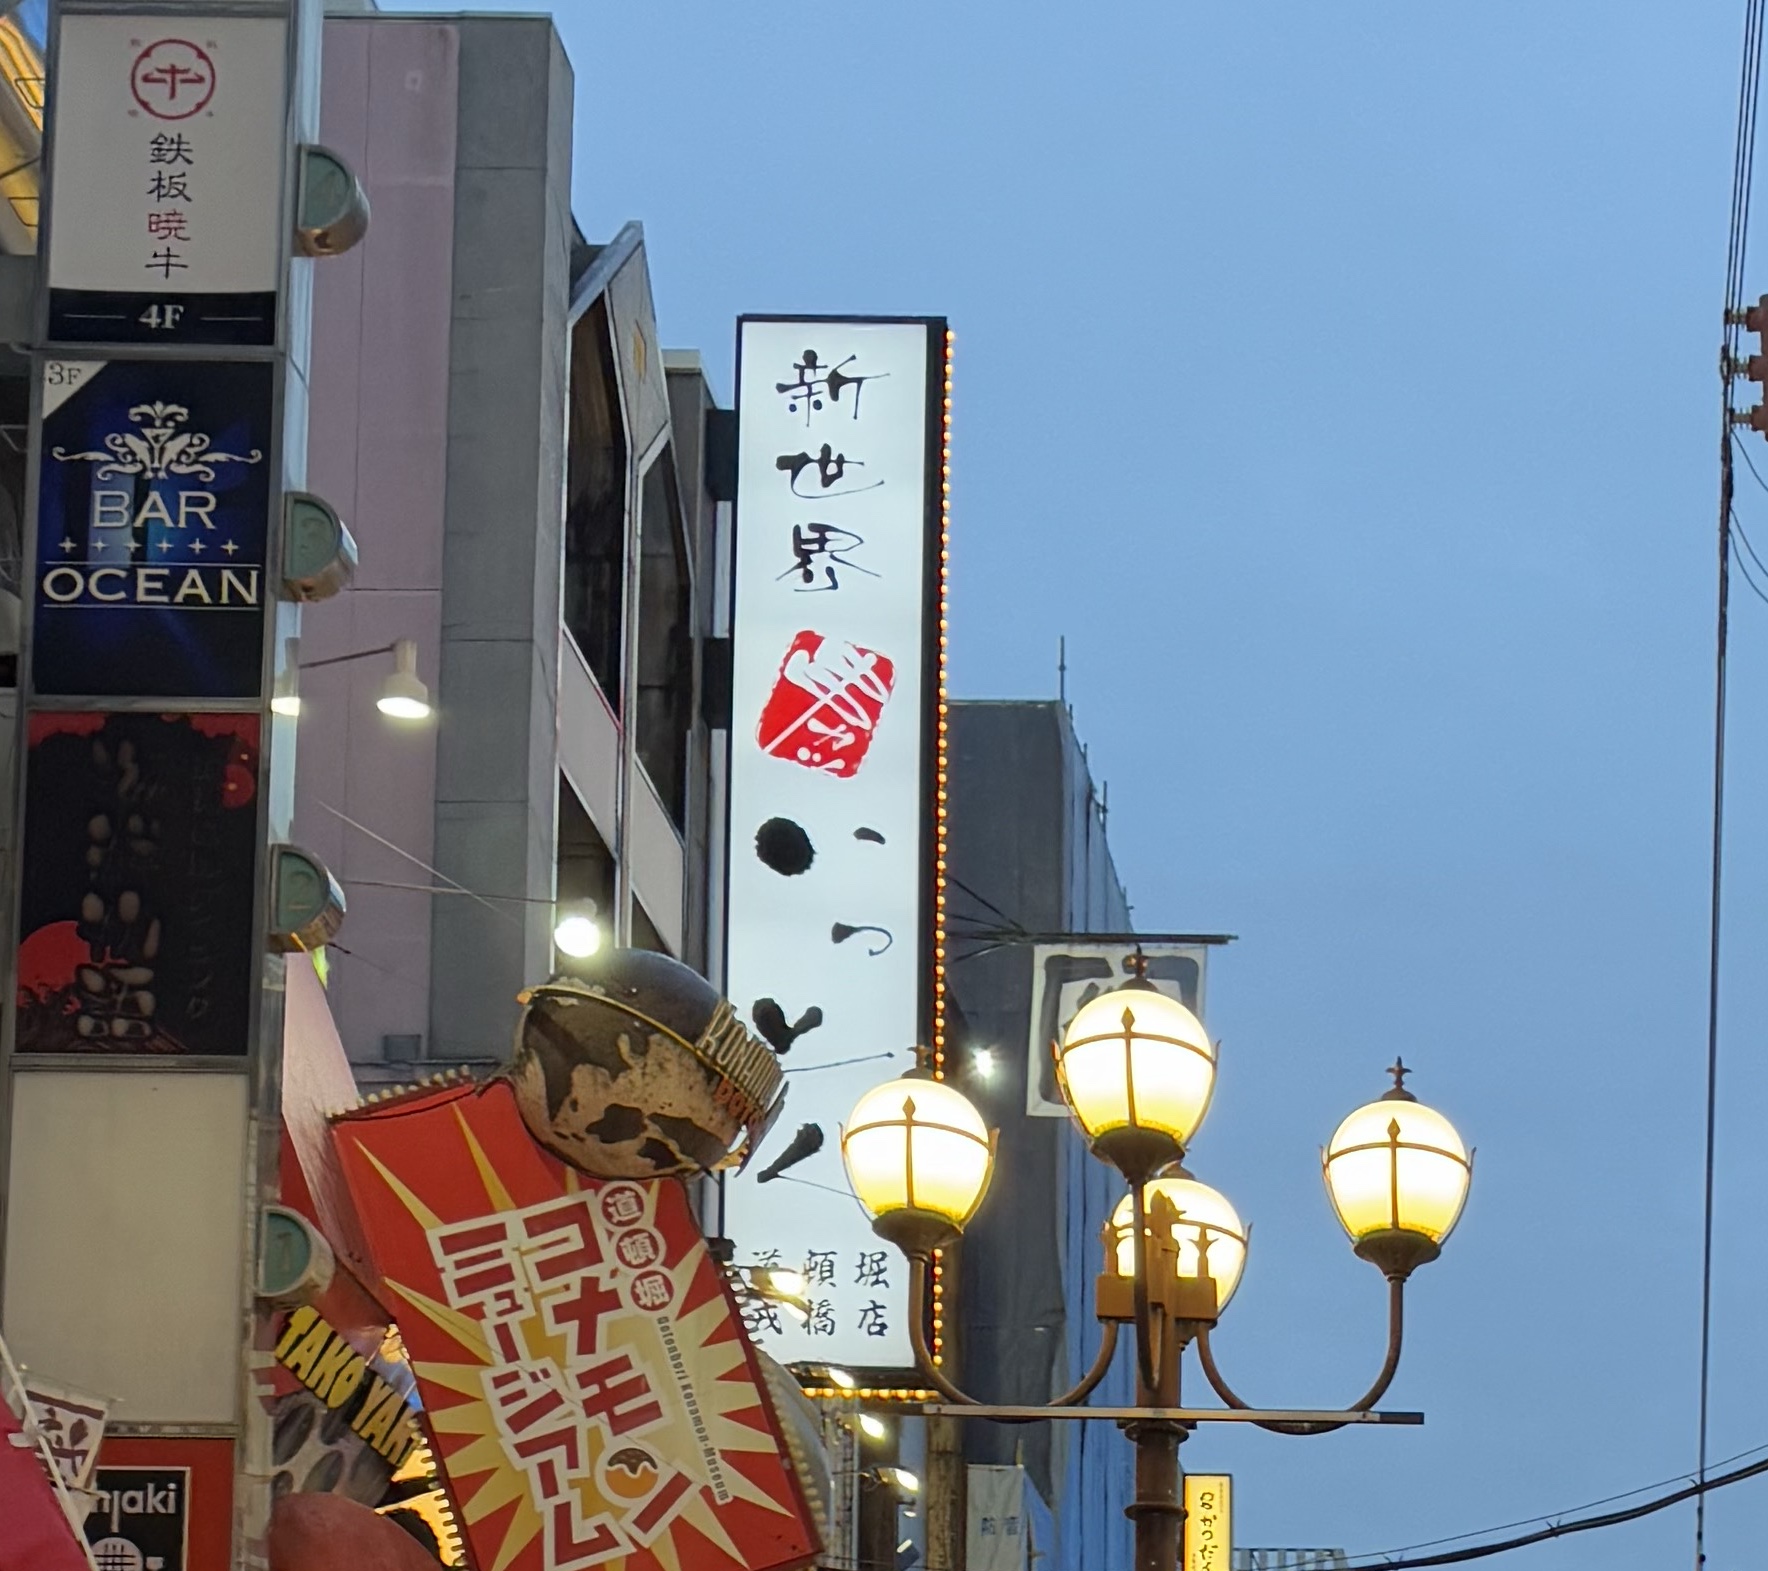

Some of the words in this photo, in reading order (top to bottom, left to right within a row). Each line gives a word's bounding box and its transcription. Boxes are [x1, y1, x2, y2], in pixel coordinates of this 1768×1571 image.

[145, 130, 193, 280] 鉄板暁牛
[138, 303, 185, 331] 4F
[47, 362, 82, 388] 3F
[92, 490, 217, 530] BAR
[775, 349, 891, 593] 新世界
[43, 569, 258, 605] OCEAN
[604, 1192, 673, 1310] 道頓堀
[276, 1305, 367, 1408] TAKO
[436, 1219, 620, 1568] ミュージアム
